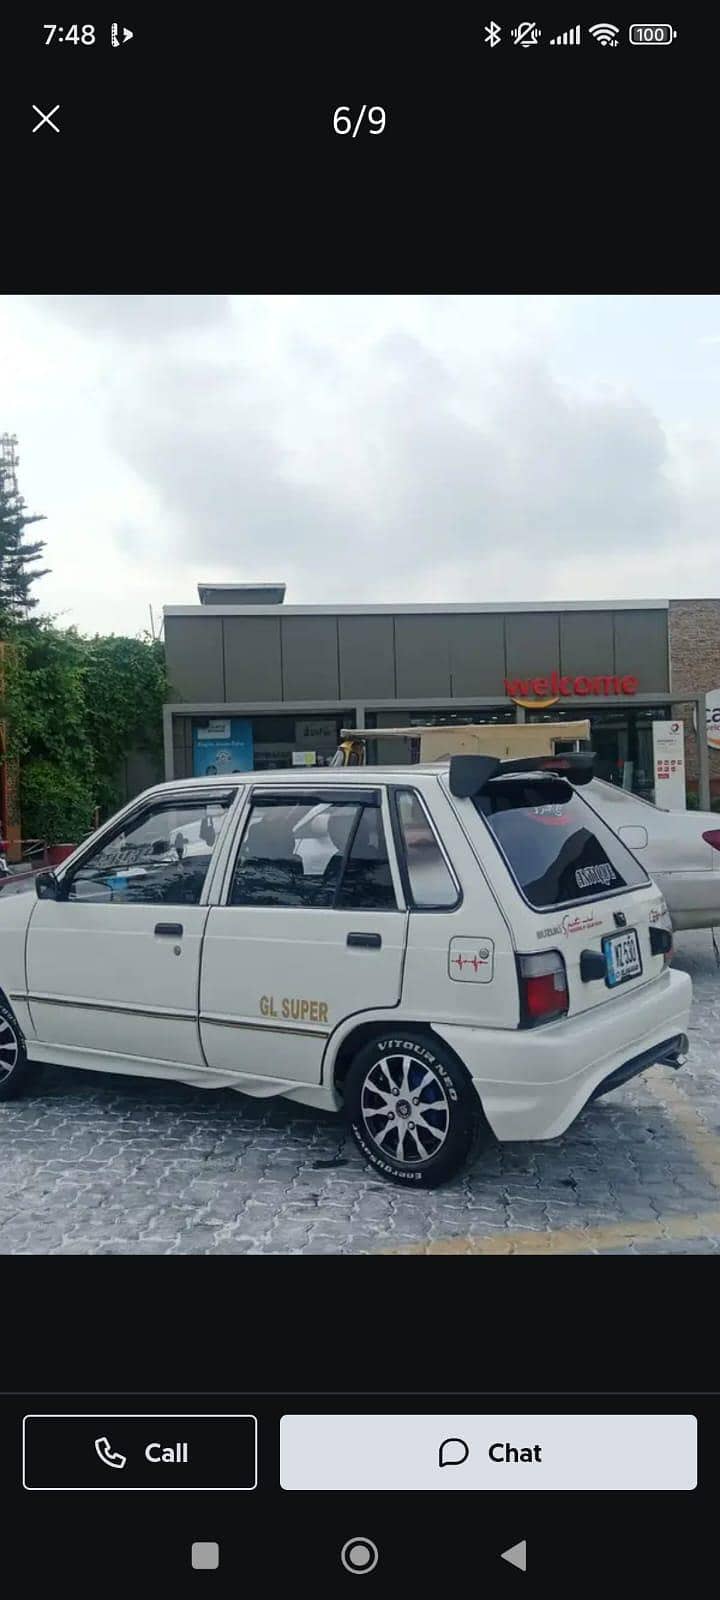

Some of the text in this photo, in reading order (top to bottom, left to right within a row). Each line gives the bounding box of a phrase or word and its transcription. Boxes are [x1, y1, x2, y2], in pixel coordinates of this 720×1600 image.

[504, 672, 639, 696] welcome
[260, 995, 328, 1022] GL SUPER
[377, 1039, 458, 1102] VITOUR NEO
